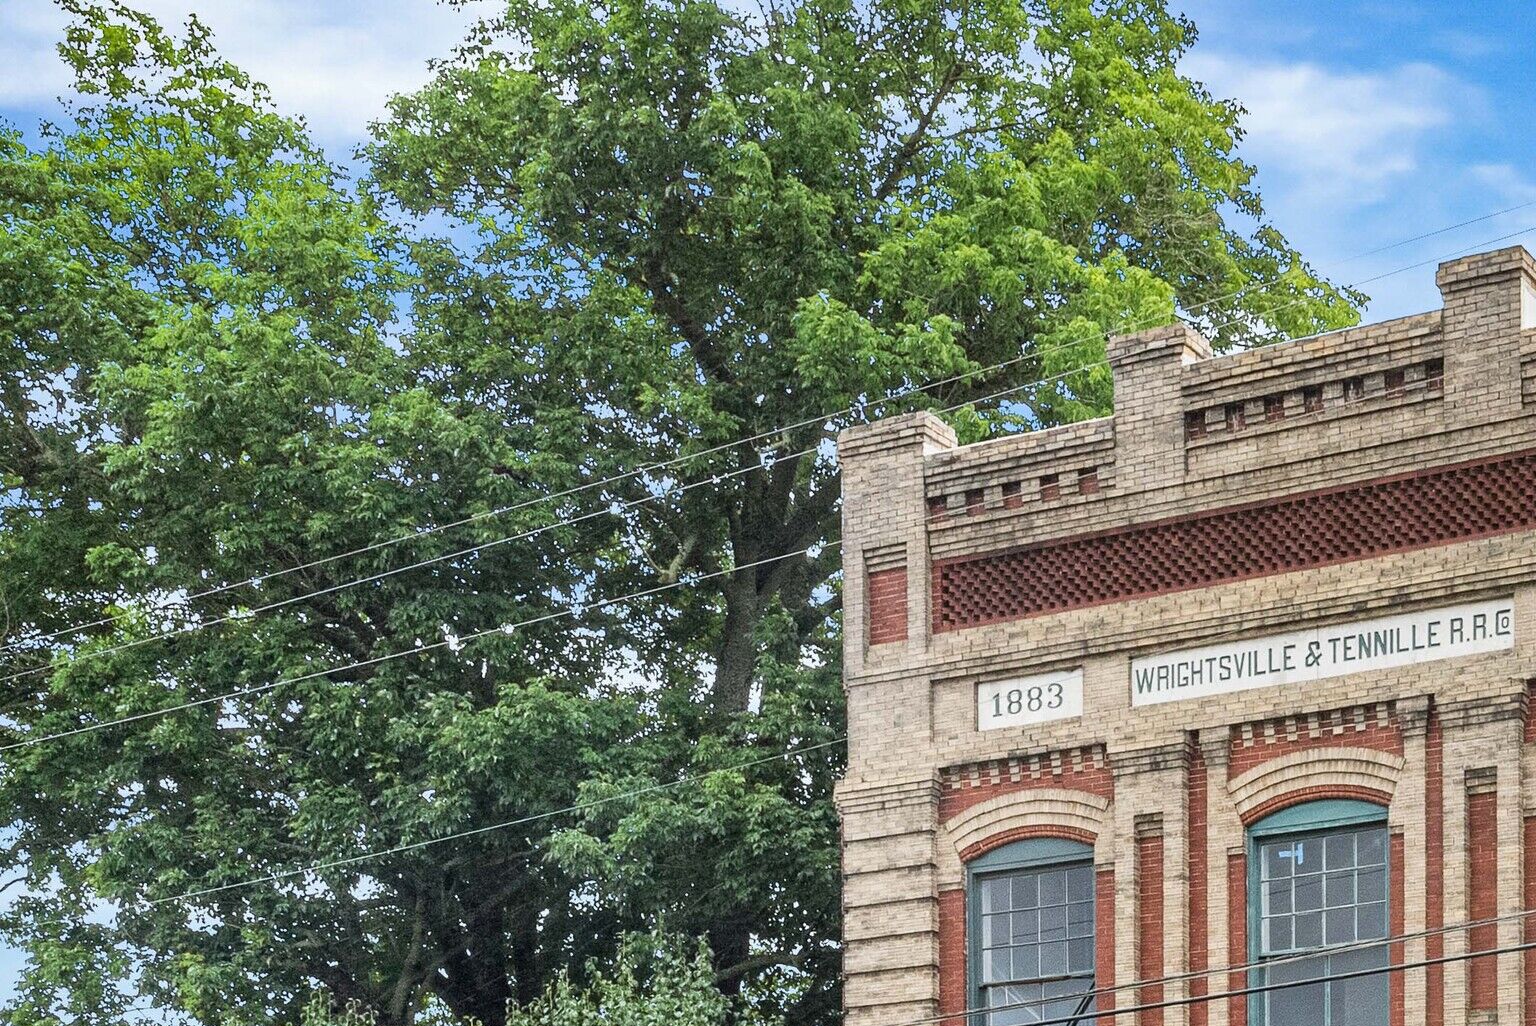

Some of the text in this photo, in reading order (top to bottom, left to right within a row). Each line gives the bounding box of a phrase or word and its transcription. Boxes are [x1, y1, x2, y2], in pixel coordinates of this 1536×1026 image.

[1136, 645, 1297, 694] WRIGHTSVILLE
[1304, 640, 1321, 668] &
[1328, 620, 1441, 664] TENNILLE
[992, 683, 1063, 718] 1883
